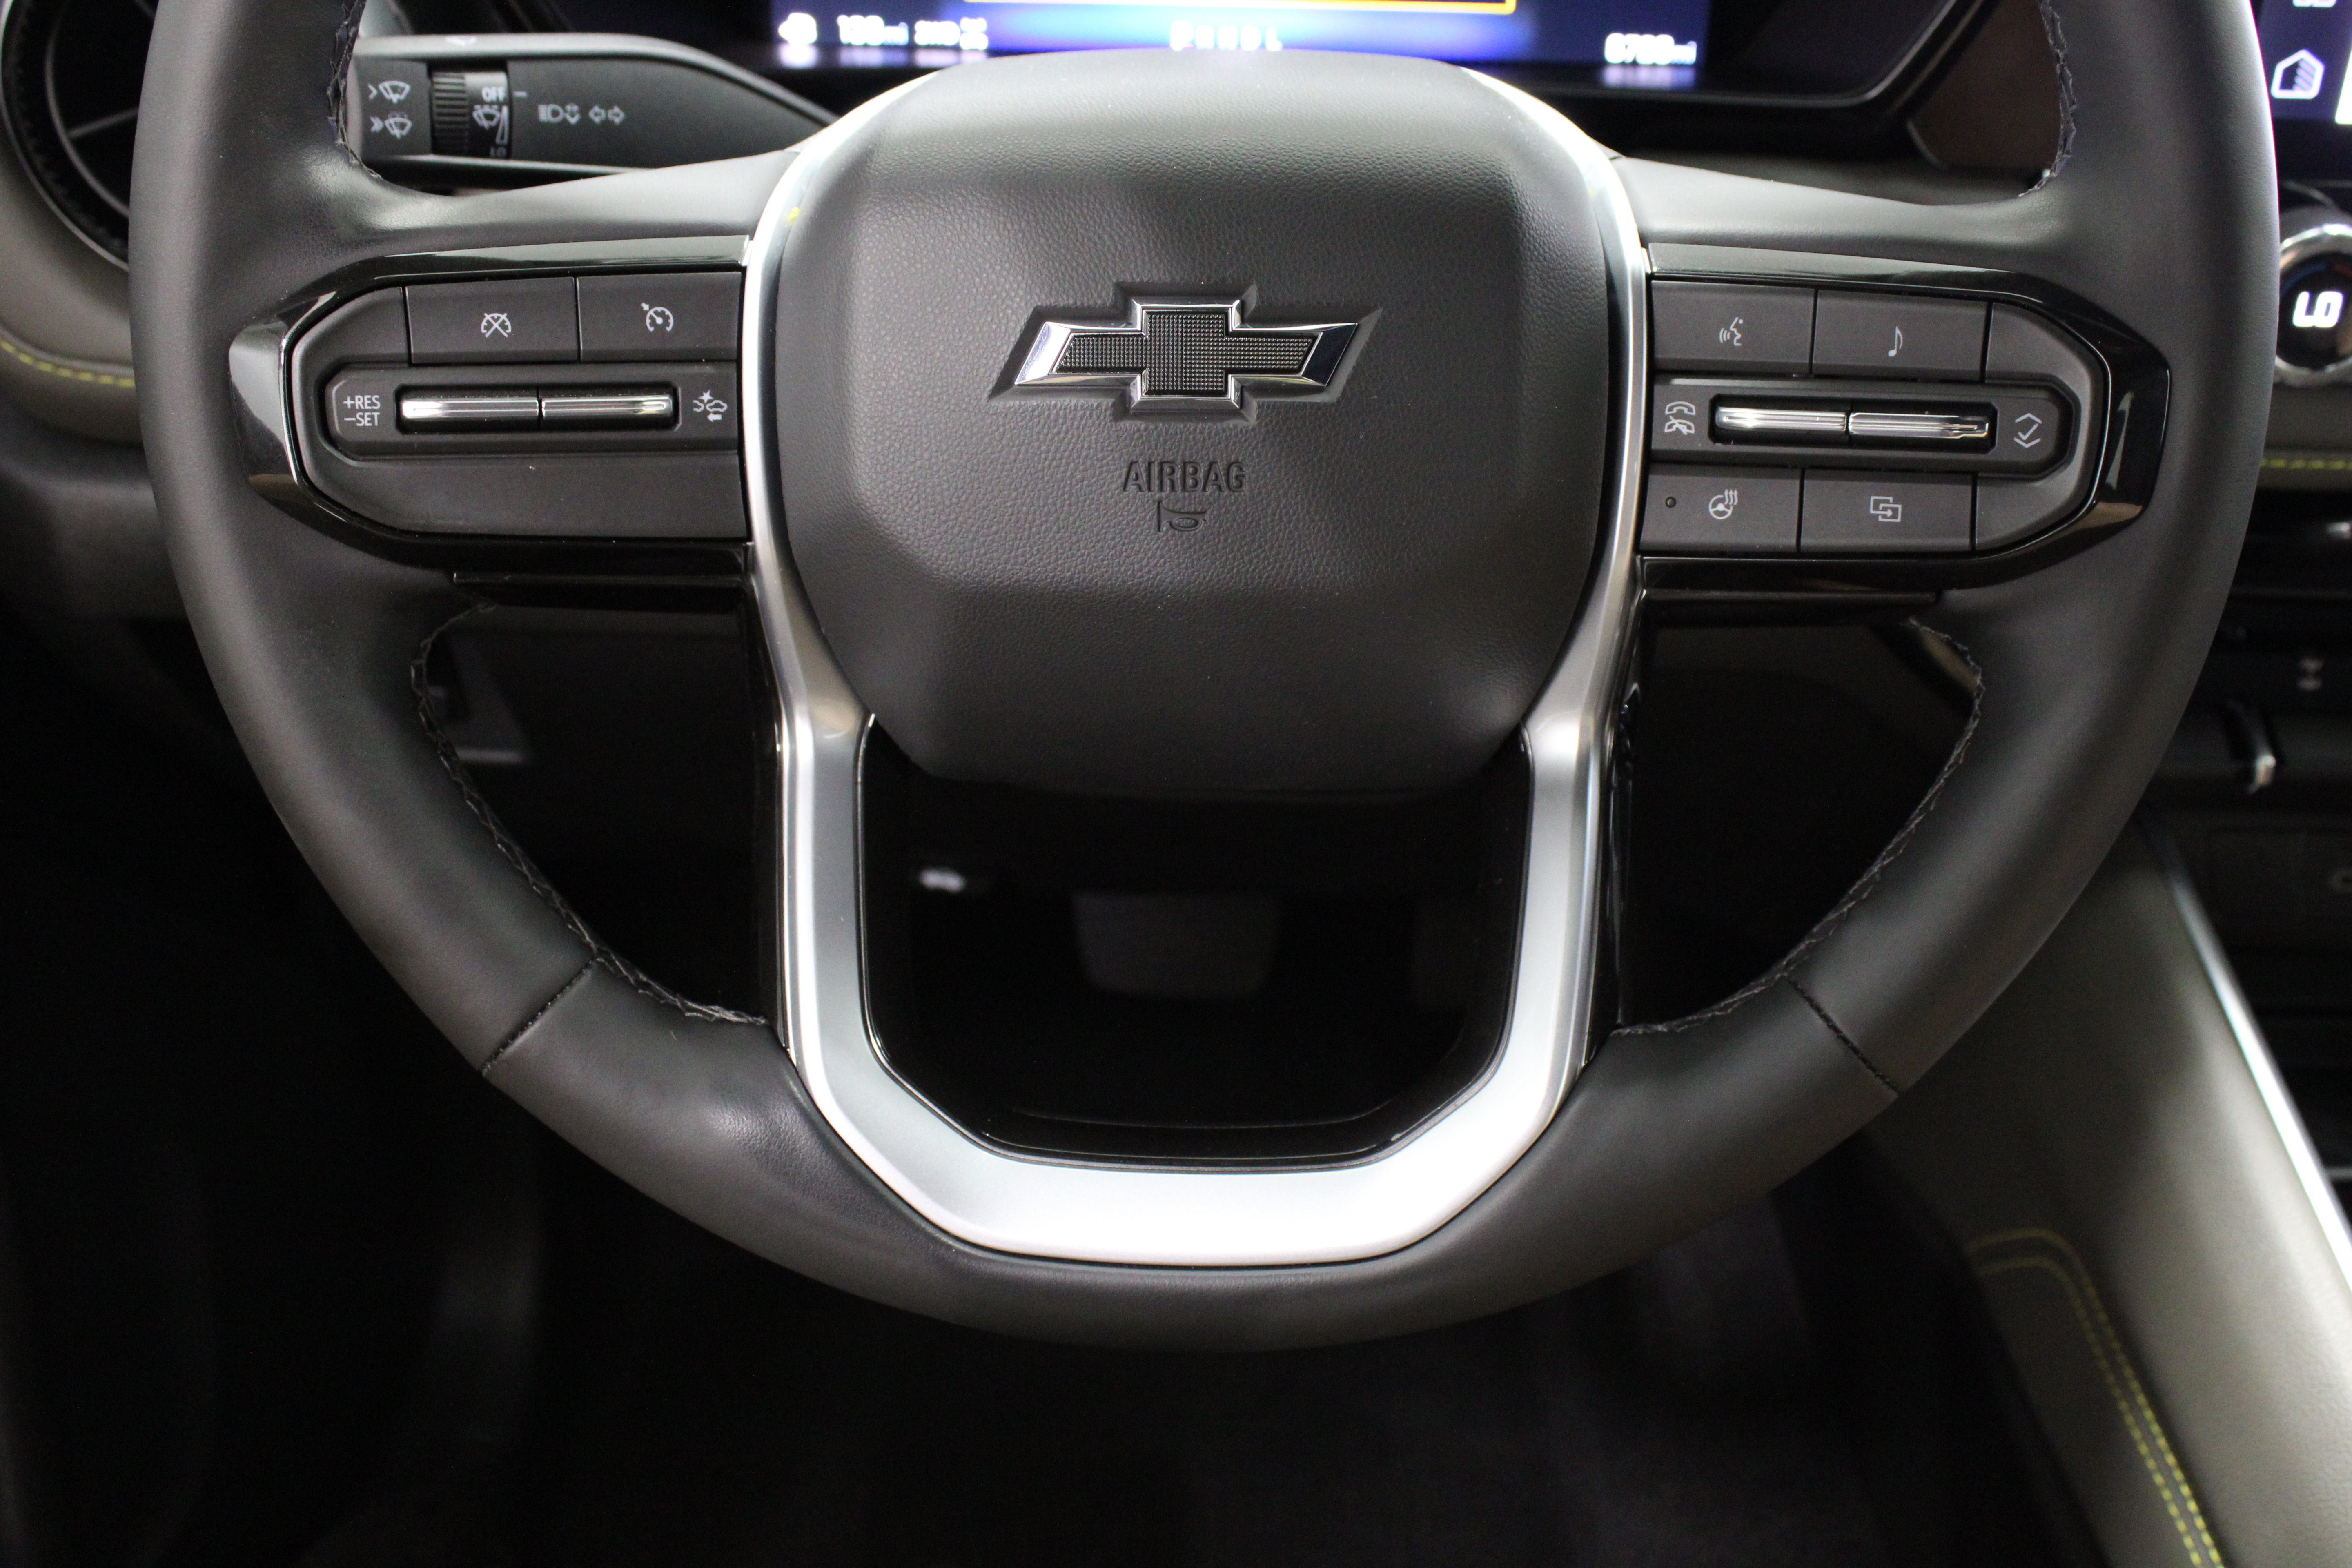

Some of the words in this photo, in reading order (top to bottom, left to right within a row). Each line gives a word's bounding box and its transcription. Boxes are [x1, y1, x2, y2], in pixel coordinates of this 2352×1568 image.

[481, 87, 505, 102] OFF
[343, 395, 381, 410] +RES
[1123, 461, 1246, 492] AIRBAG
